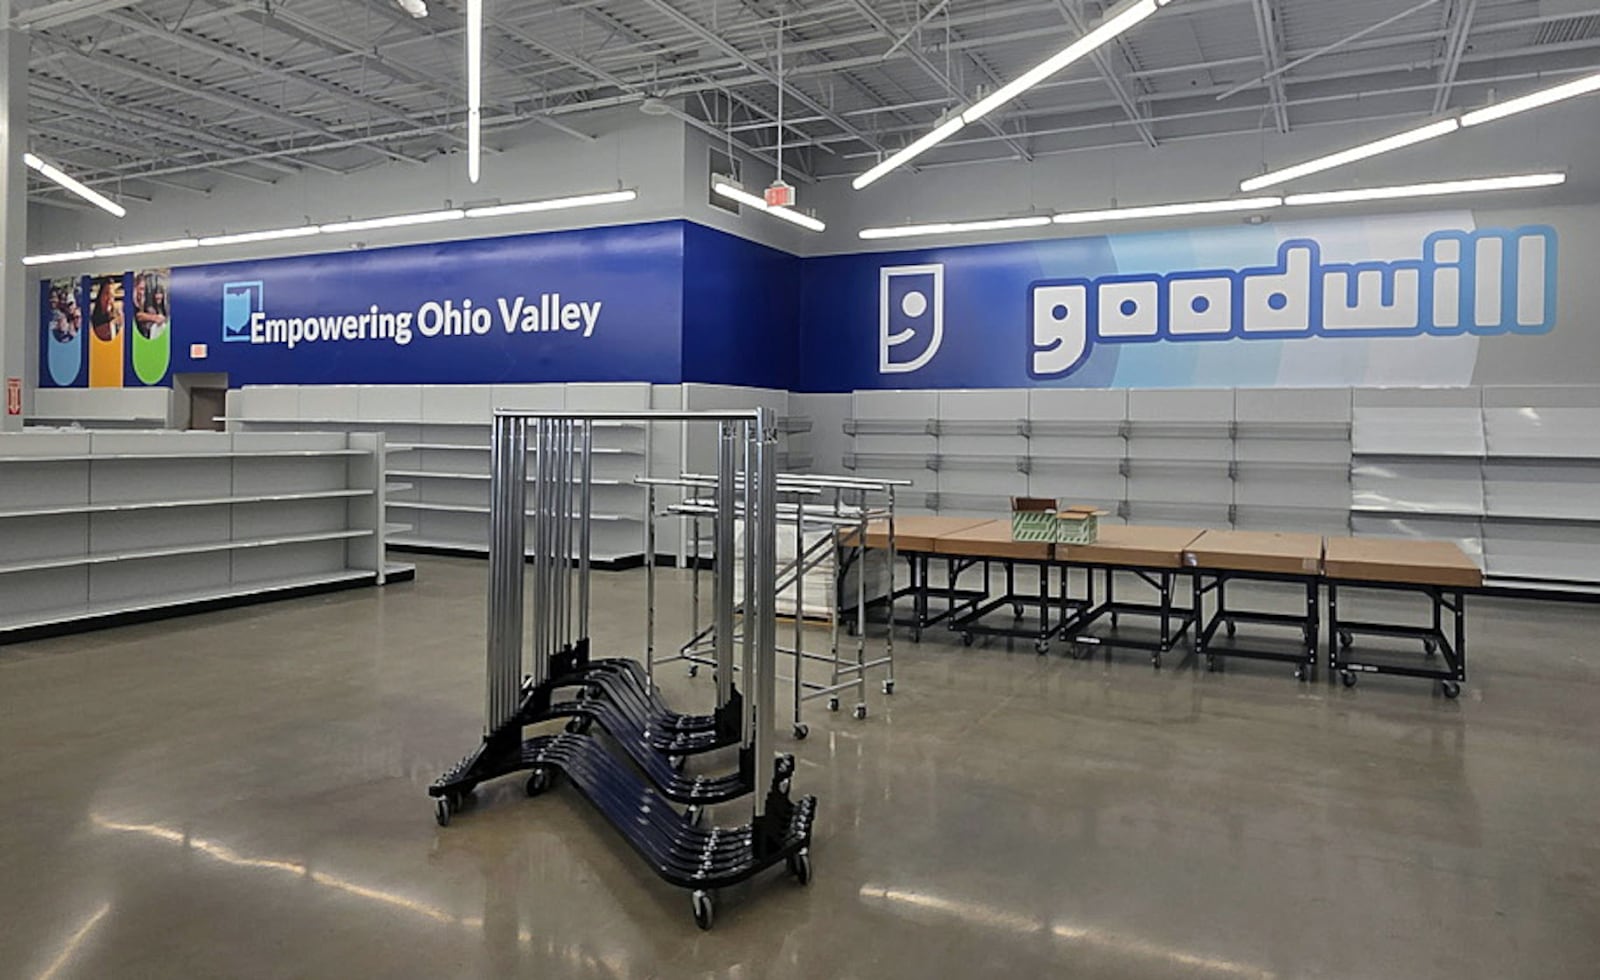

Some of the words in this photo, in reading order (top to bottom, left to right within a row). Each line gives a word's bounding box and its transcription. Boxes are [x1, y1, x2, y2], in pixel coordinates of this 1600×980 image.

[251, 304, 413, 349] Empowering
[417, 299, 492, 337] Ohio
[497, 293, 602, 338] Valley
[1028, 226, 1557, 379] goodwill
